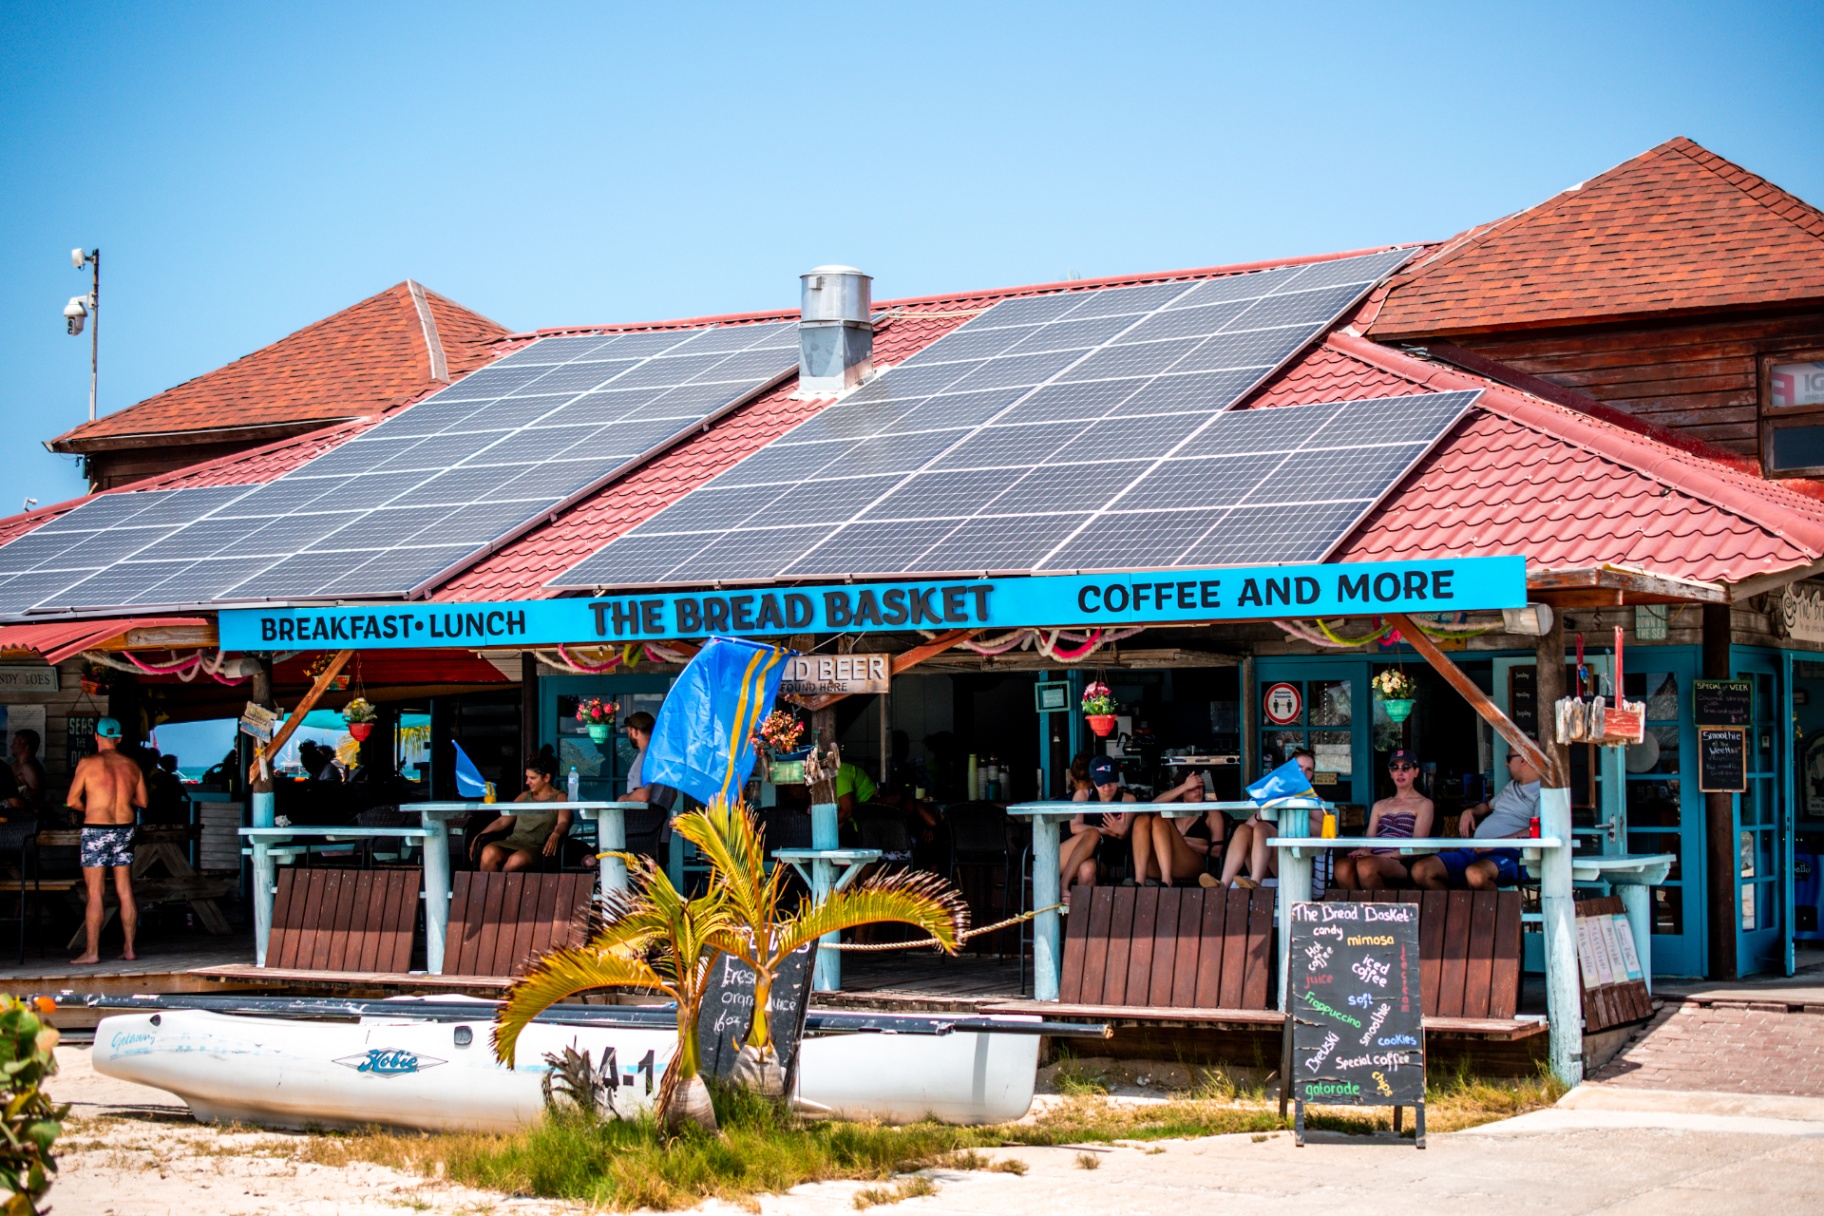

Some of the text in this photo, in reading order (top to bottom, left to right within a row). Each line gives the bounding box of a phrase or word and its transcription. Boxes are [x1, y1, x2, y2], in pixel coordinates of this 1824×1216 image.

[1077, 569, 1455, 613] COFFEE AND MORE
[588, 584, 994, 636] THE BREAD BASKET
[260, 609, 526, 642] BREAKFAST LUNCH
[1651, 628, 1667, 640] SEA
[818, 656, 887, 681] BEER
[24, 673, 51, 686] TOES
[780, 682, 849, 693] FOUND HERE
[1696, 682, 1721, 690] SPECIAL
[69, 718, 94, 735] SEAS
[1702, 731, 1742, 741] Smoothie
[1293, 904, 1410, 923] The Bread Basket
[1313, 925, 1343, 941] candy
[1347, 935, 1395, 946] mimosa
[1305, 941, 1324, 958] Hot
[1308, 946, 1334, 972] coffee
[1362, 954, 1391, 975] iced
[1305, 991, 1361, 1029] Frappuccino
[1359, 1002, 1391, 1047] smoothie
[357, 1049, 419, 1073] Hobie
[1335, 1054, 1372, 1071] Special
[1305, 1081, 1360, 1100] gatorade
